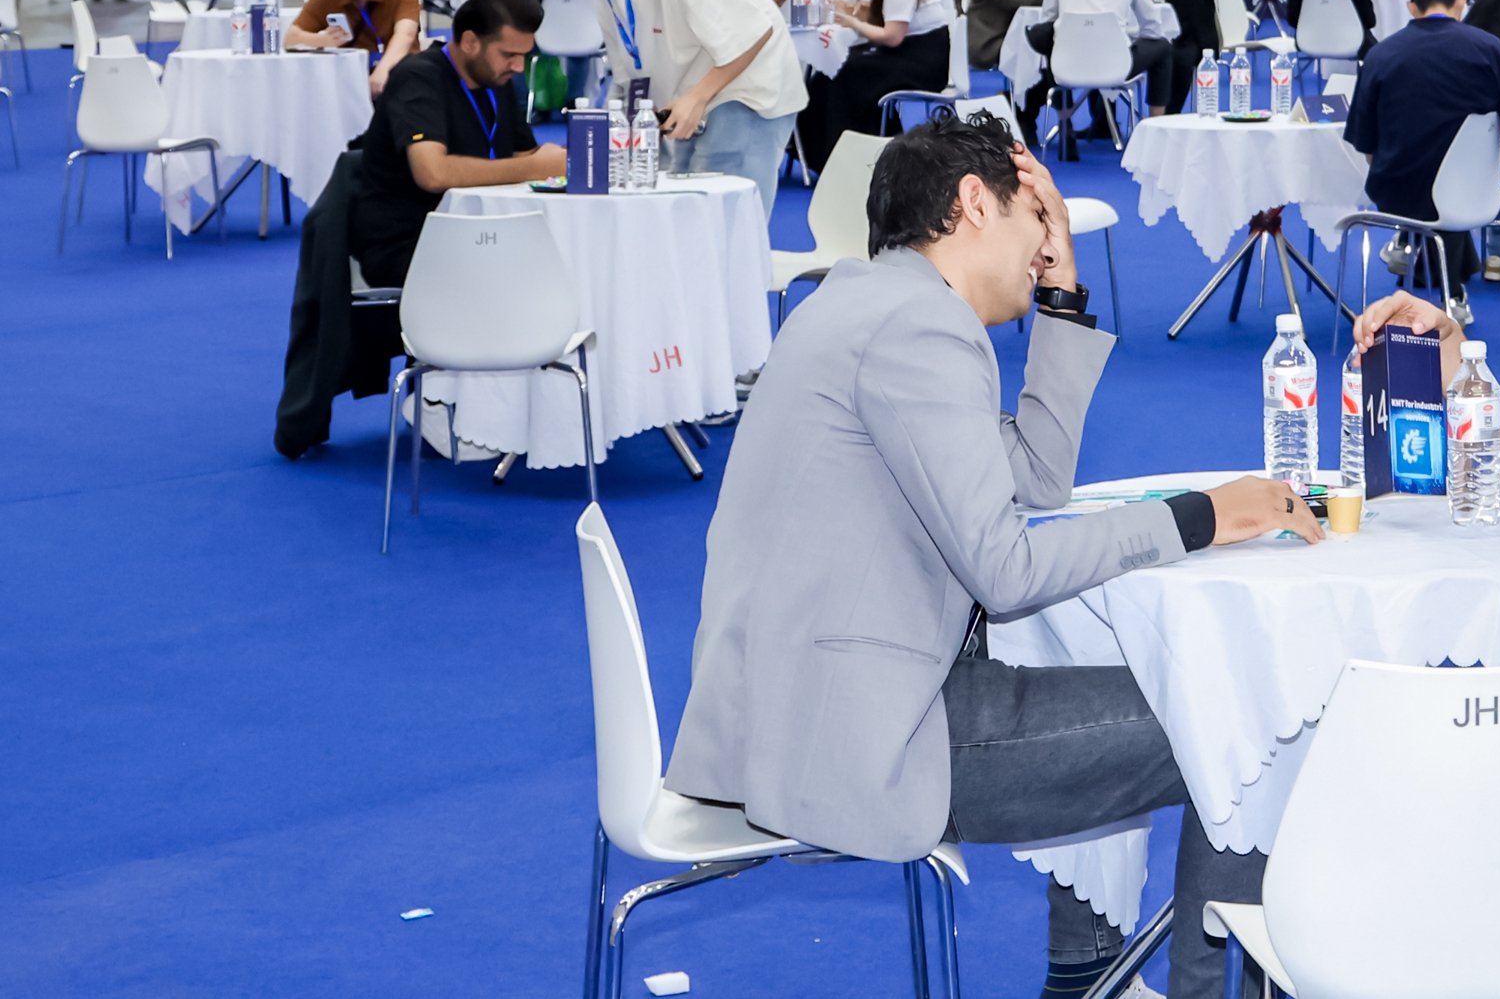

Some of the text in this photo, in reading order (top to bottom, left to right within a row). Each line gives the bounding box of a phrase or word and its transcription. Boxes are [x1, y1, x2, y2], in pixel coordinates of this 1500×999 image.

[1321, 103, 1335, 115] 4
[475, 231, 498, 246] JH
[1391, 333, 1406, 343] 2025
[649, 345, 683, 374] JH
[1366, 388, 1389, 437] 14
[1453, 696, 1498, 728] JH
